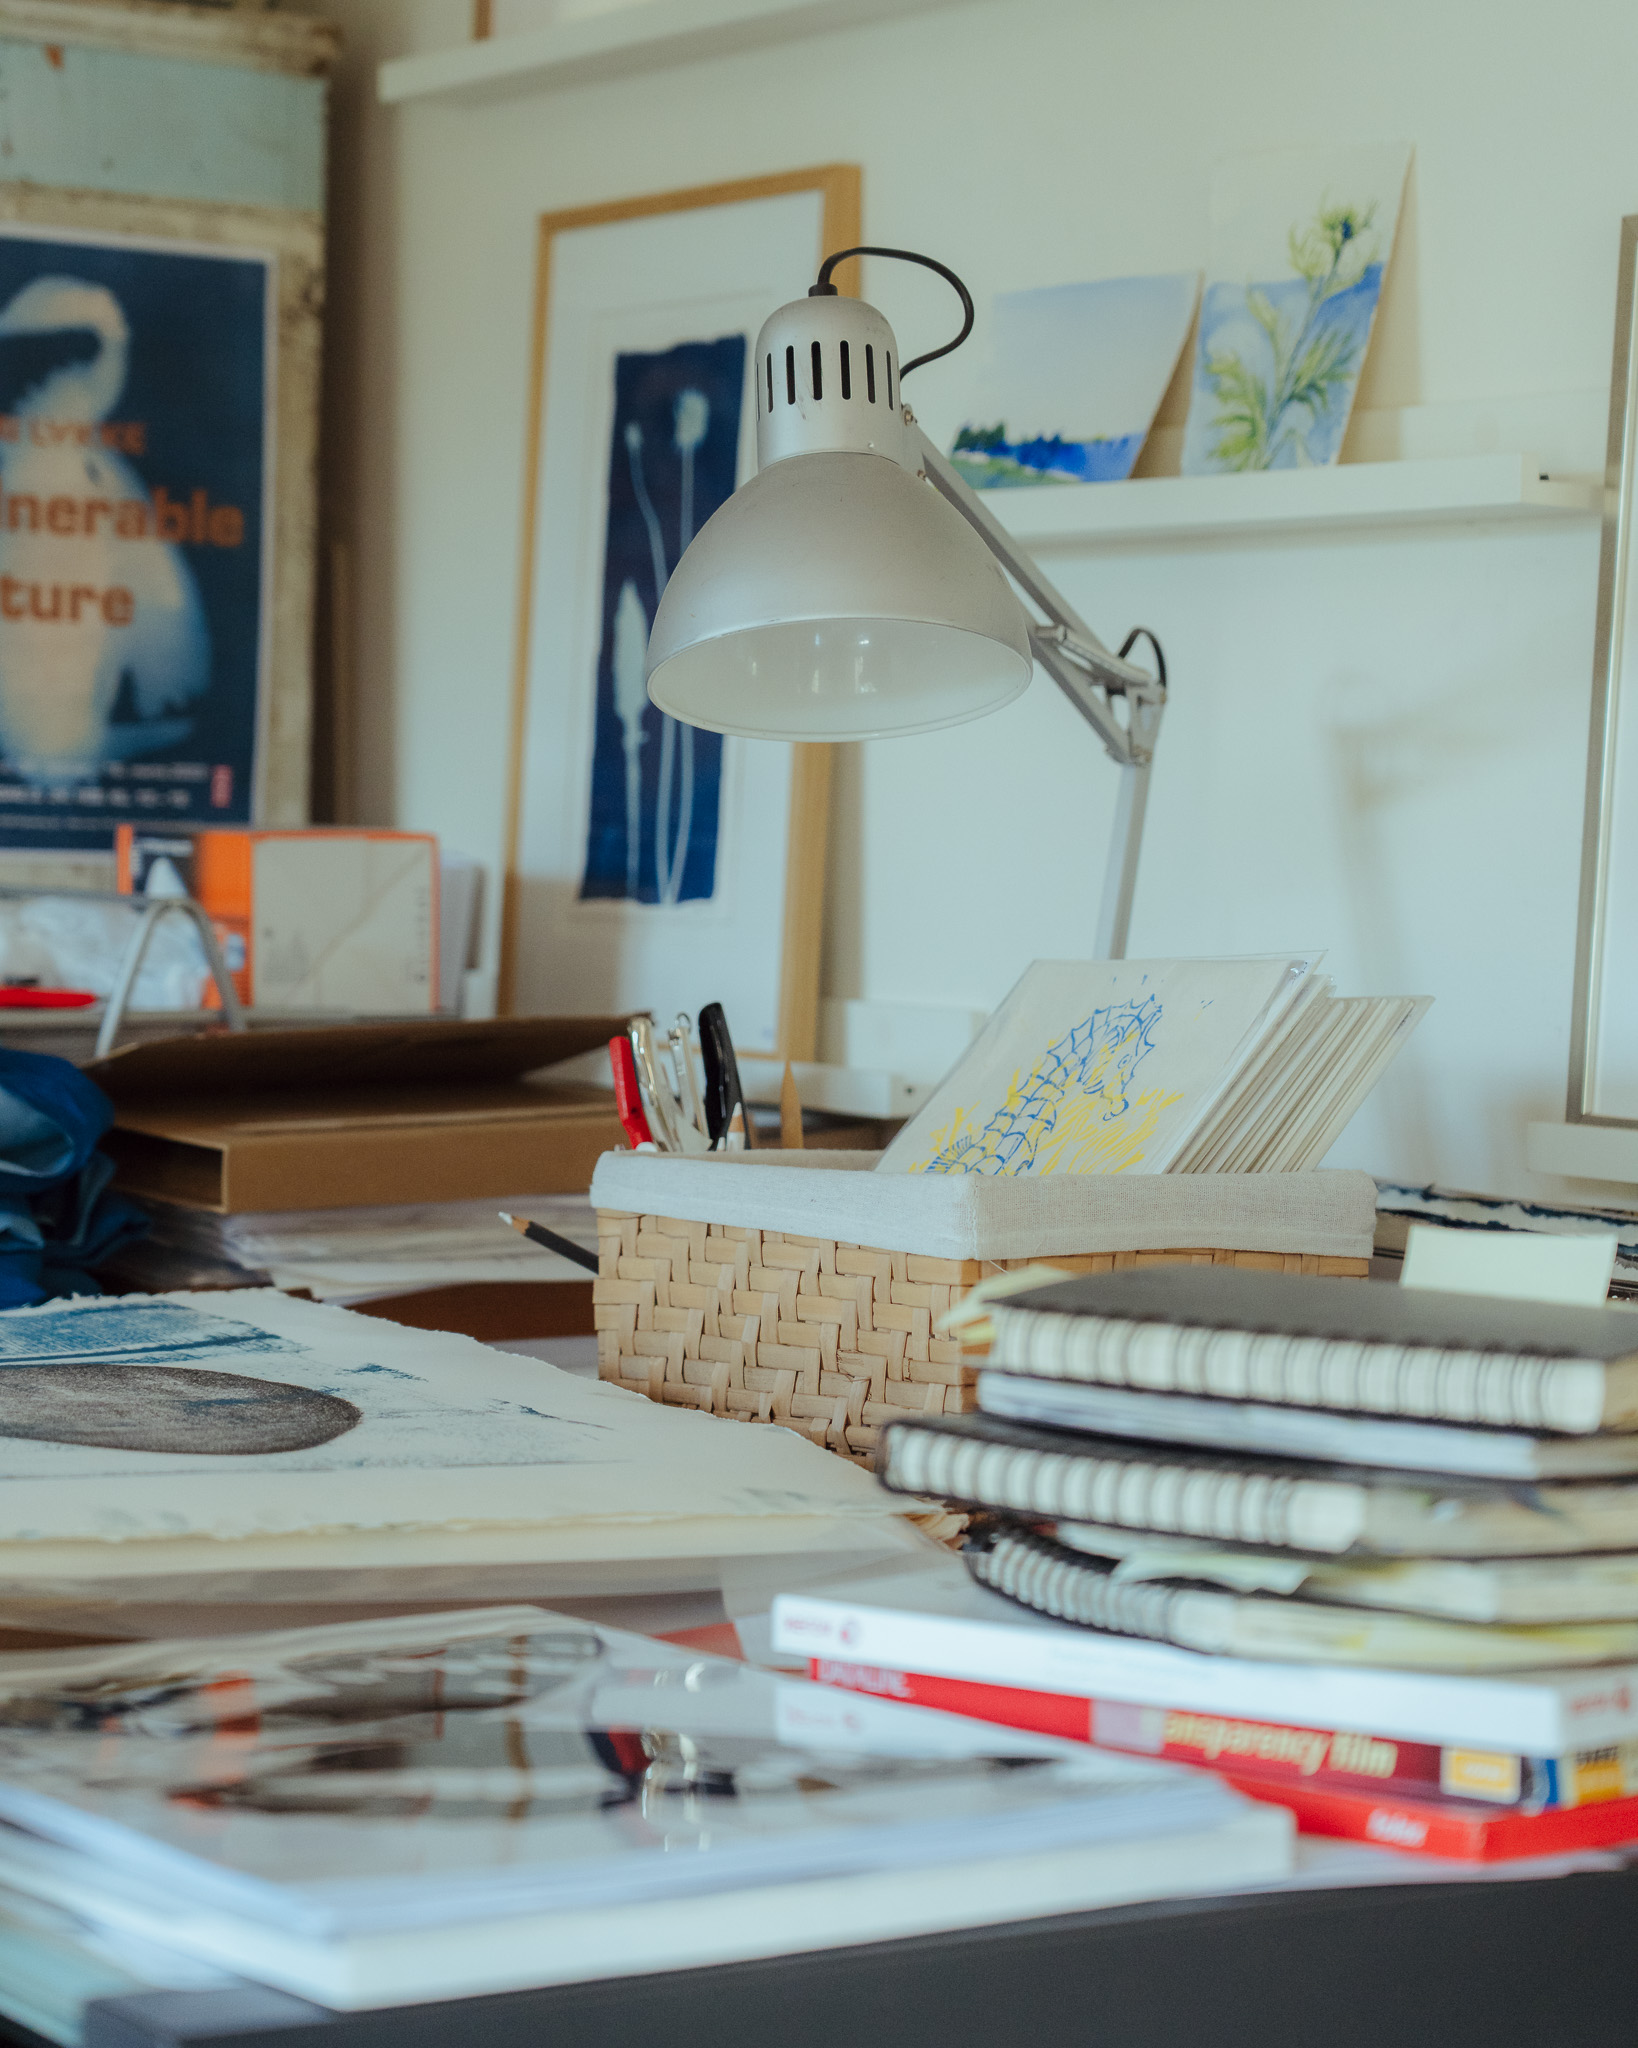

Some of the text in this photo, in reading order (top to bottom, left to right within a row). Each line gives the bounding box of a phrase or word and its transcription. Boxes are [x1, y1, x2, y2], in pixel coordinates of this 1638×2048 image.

[0, 484, 245, 548] nerable
[1162, 1711, 1399, 1780] ansparency film
